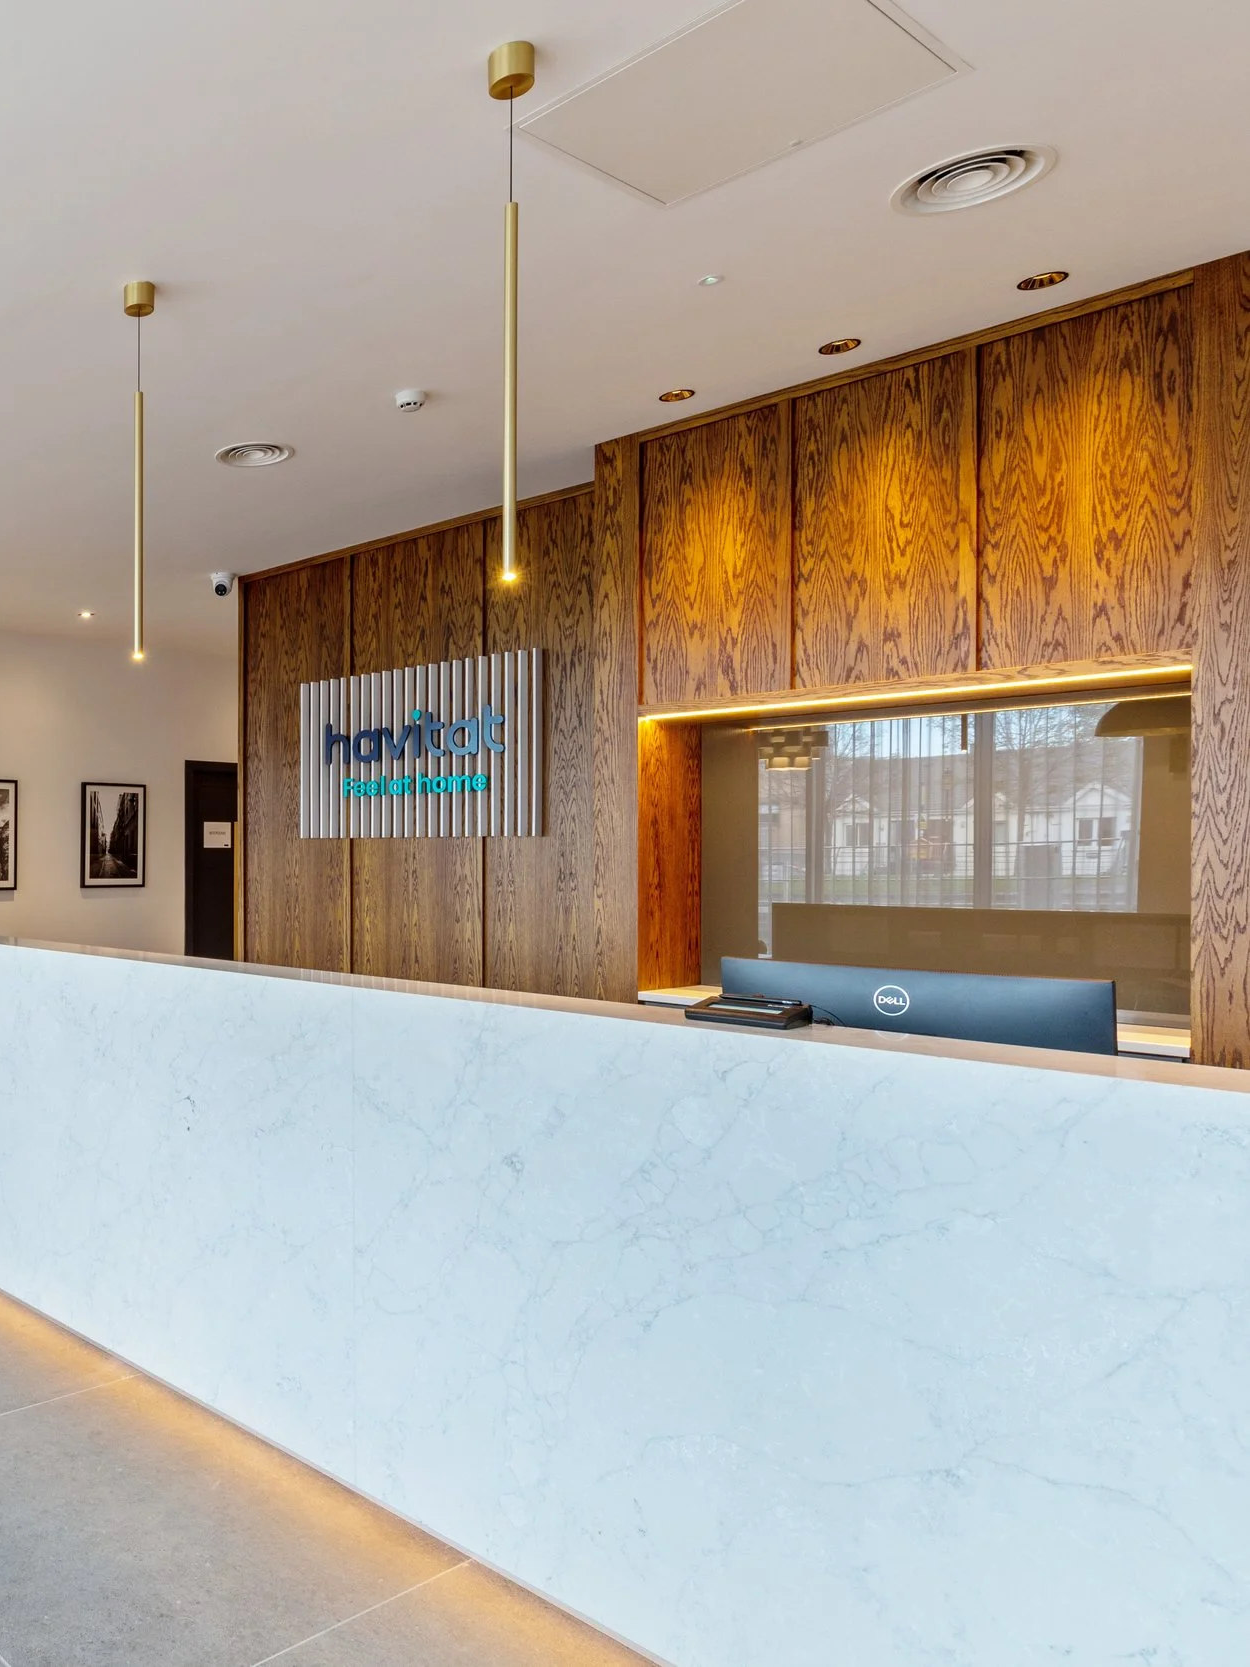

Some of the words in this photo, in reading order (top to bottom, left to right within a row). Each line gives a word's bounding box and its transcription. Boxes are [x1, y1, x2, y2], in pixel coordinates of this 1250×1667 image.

[325, 704, 506, 766] havitat
[343, 775, 386, 797] Feel
[389, 774, 412, 795] at
[417, 772, 488, 794] home
[878, 995, 906, 1006] DELL
